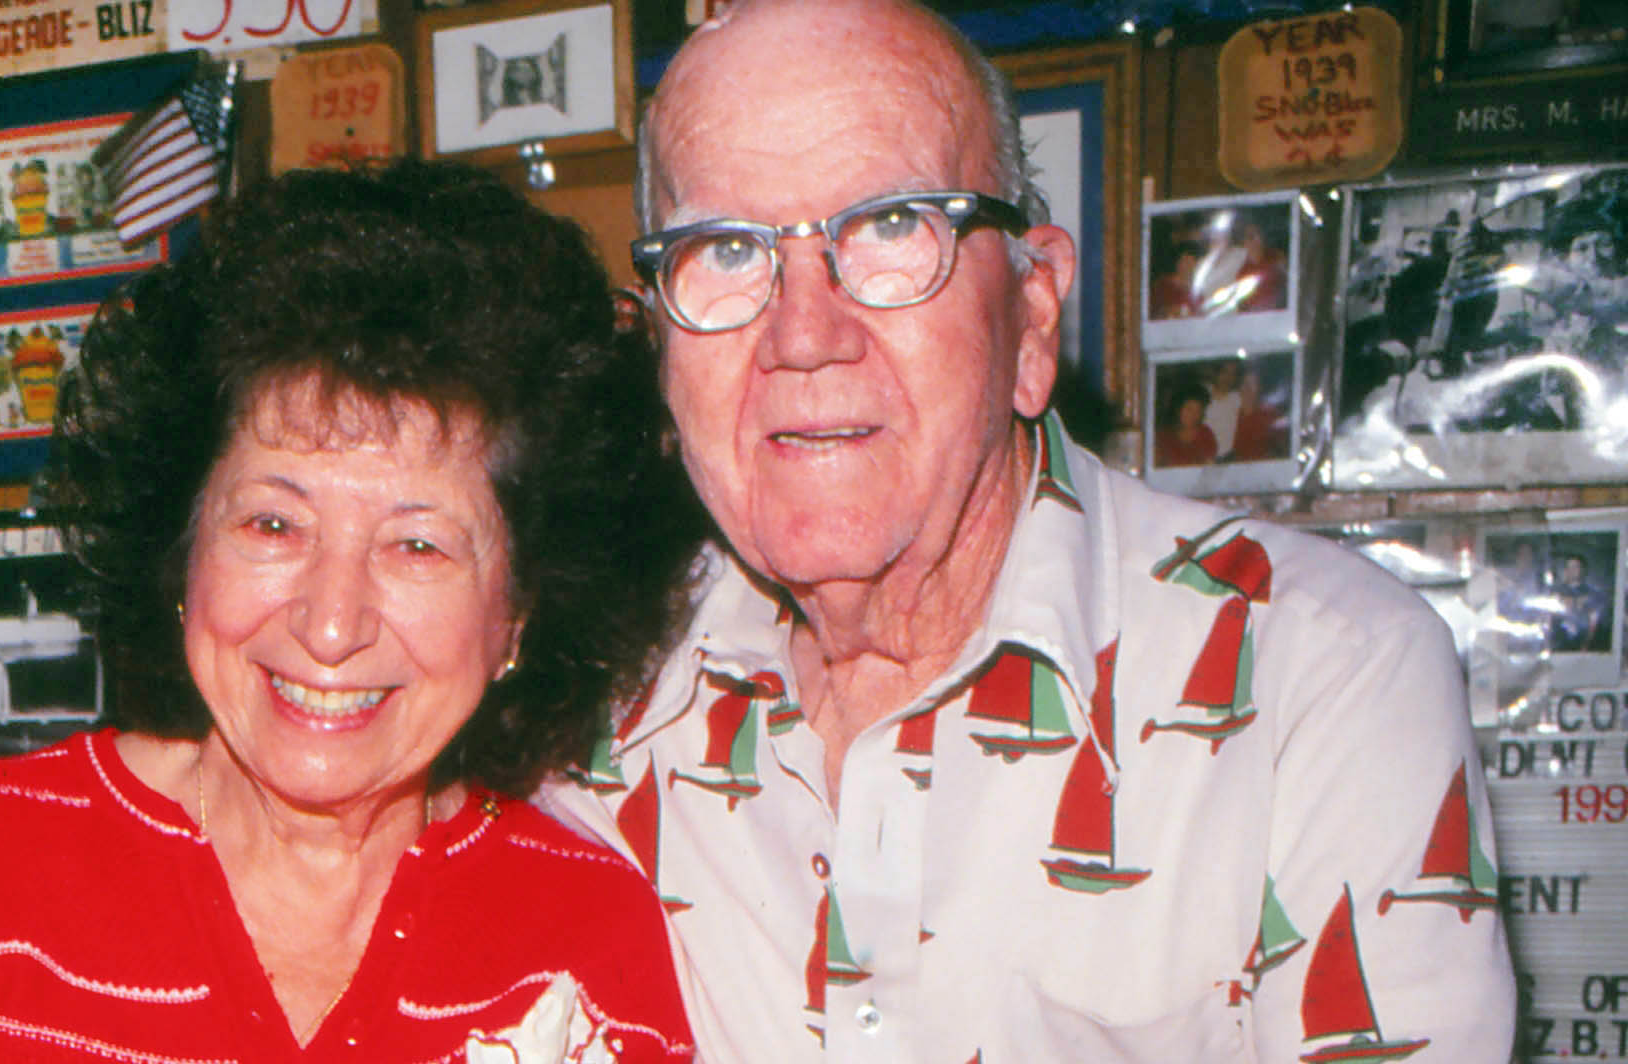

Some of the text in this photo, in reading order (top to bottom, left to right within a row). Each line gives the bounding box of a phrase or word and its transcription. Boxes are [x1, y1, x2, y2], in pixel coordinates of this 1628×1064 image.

[1252, 13, 1365, 56] YEAR
[1283, 52, 1358, 91] 1939
[1457, 103, 1525, 133] MRS.
[1548, 100, 1579, 127] M.
[1582, 975, 1628, 1013] OF
